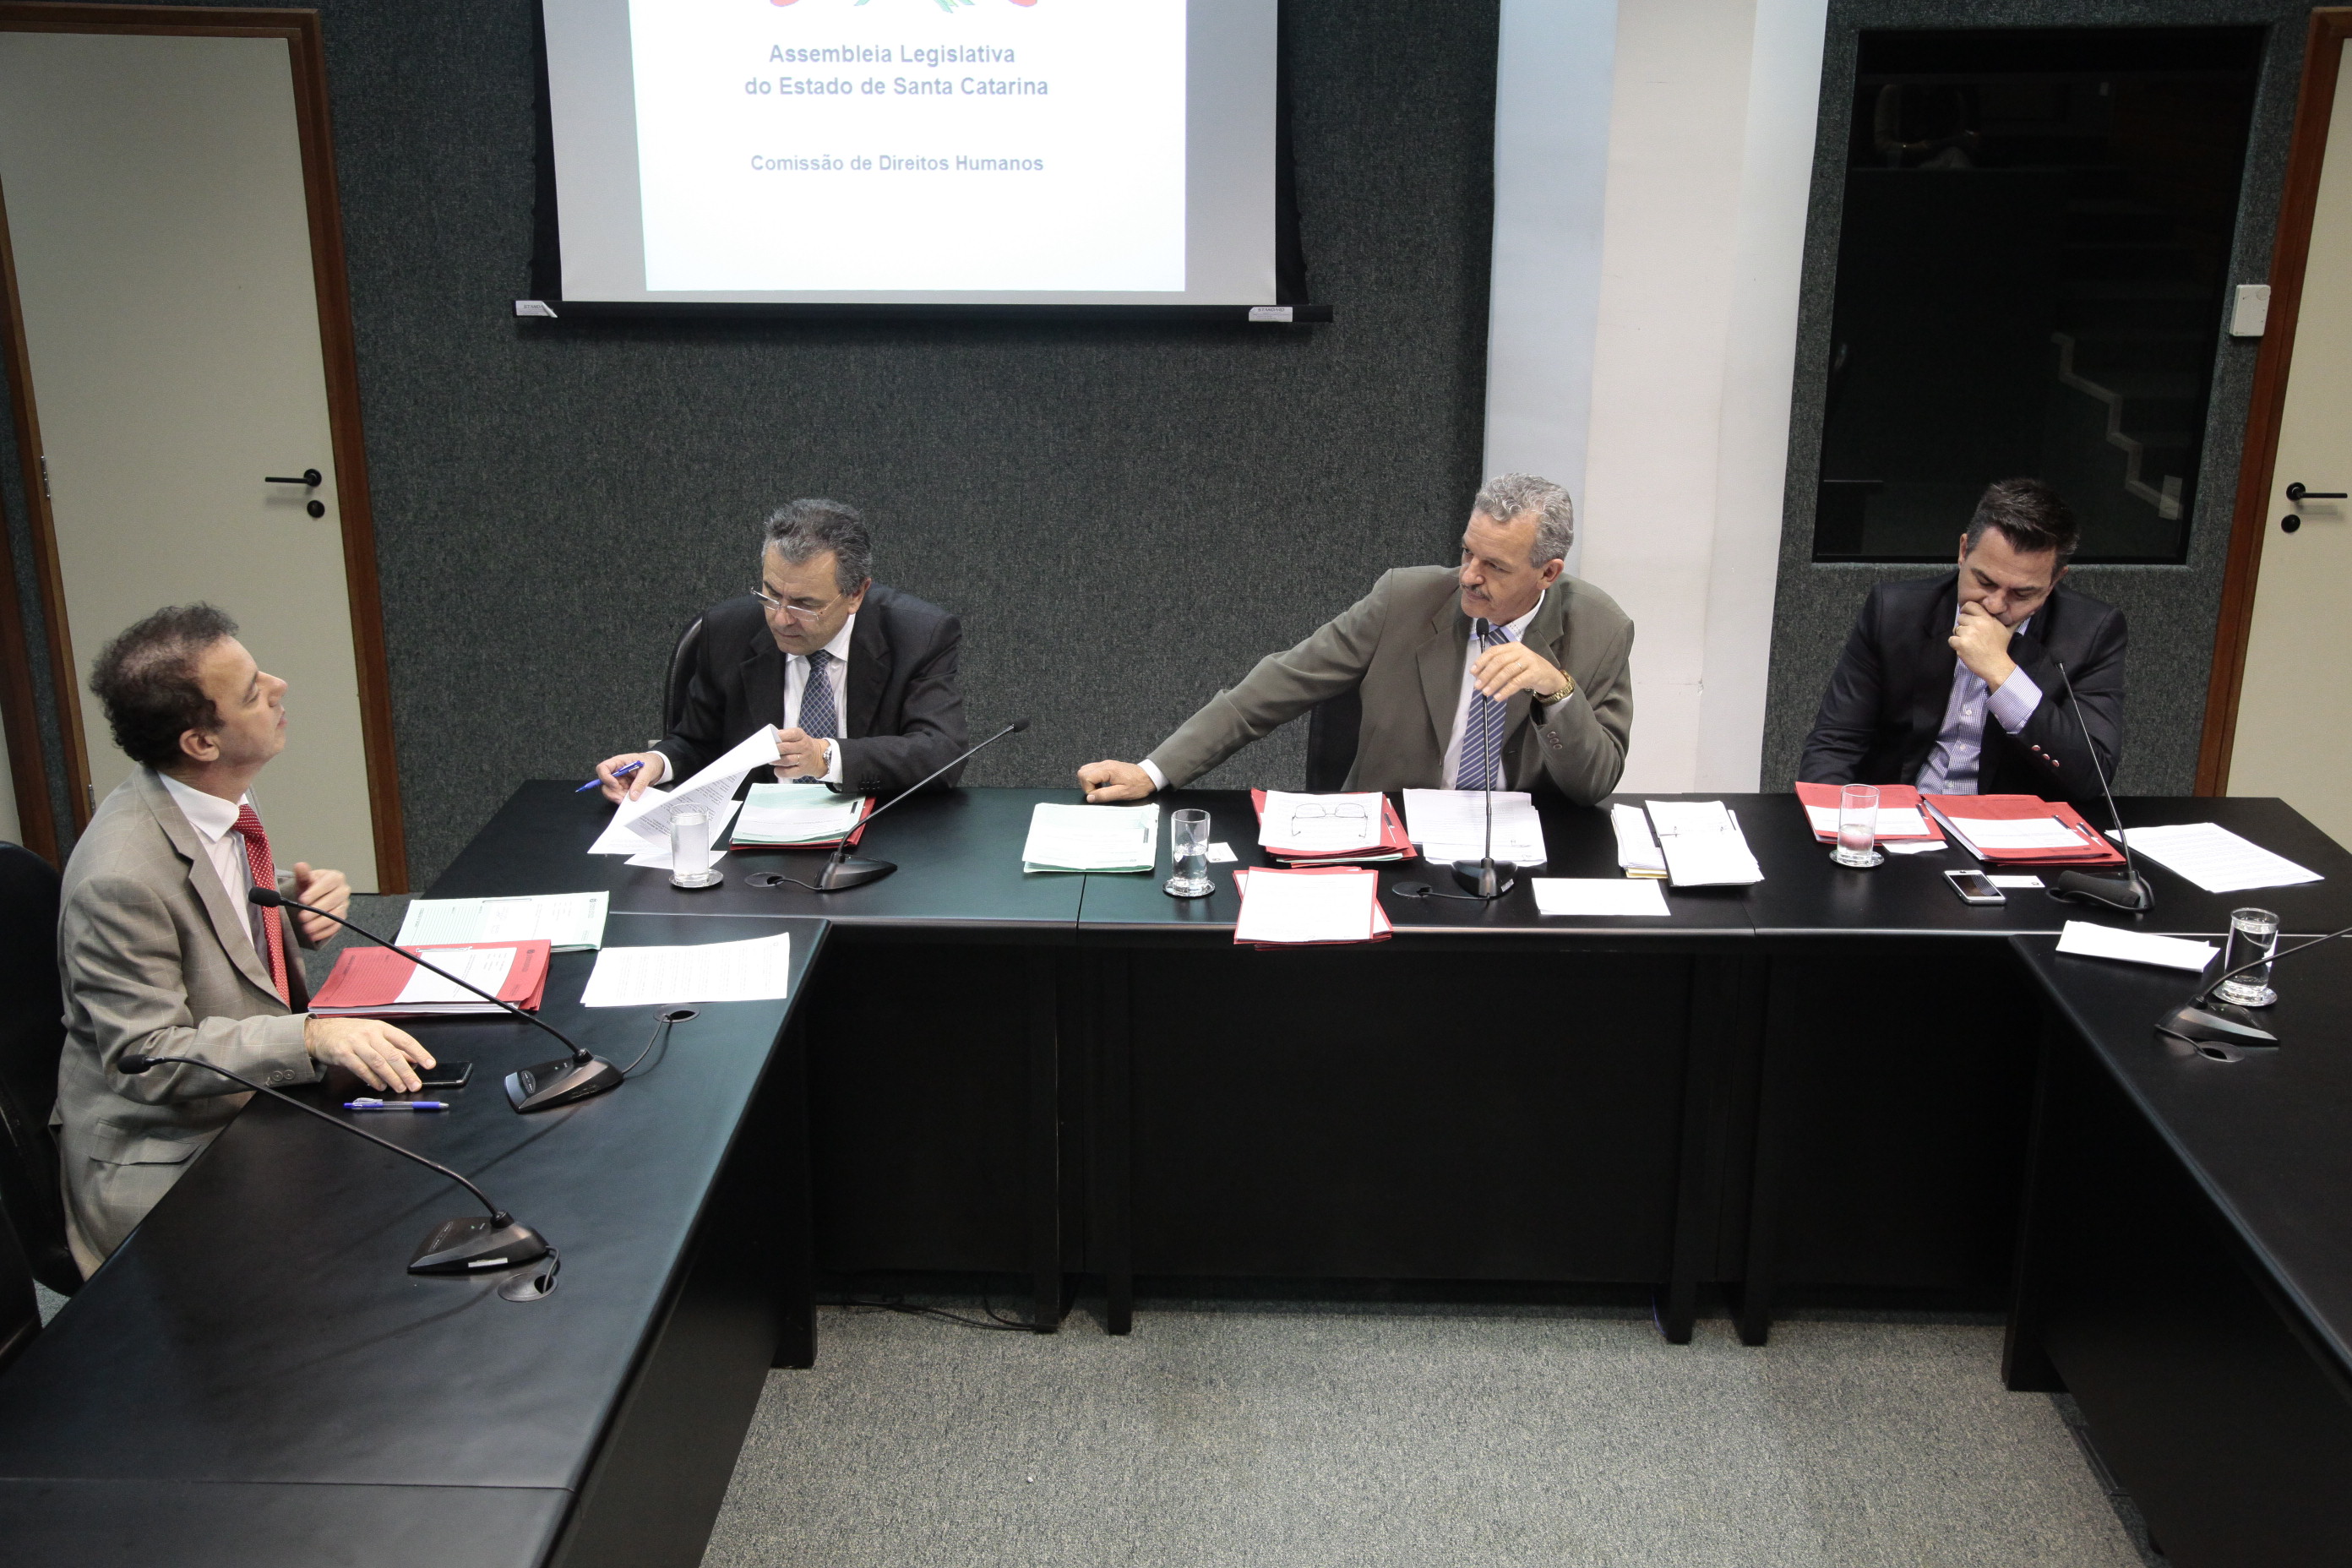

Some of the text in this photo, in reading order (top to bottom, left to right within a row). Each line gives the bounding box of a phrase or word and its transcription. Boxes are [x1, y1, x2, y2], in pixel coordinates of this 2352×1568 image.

[769, 44, 1015, 68] Assembleia Legislativa
[744, 77, 1048, 95] do Estado de Santa Catarina
[750, 154, 1044, 171] Comissão de Direitos Humanos
